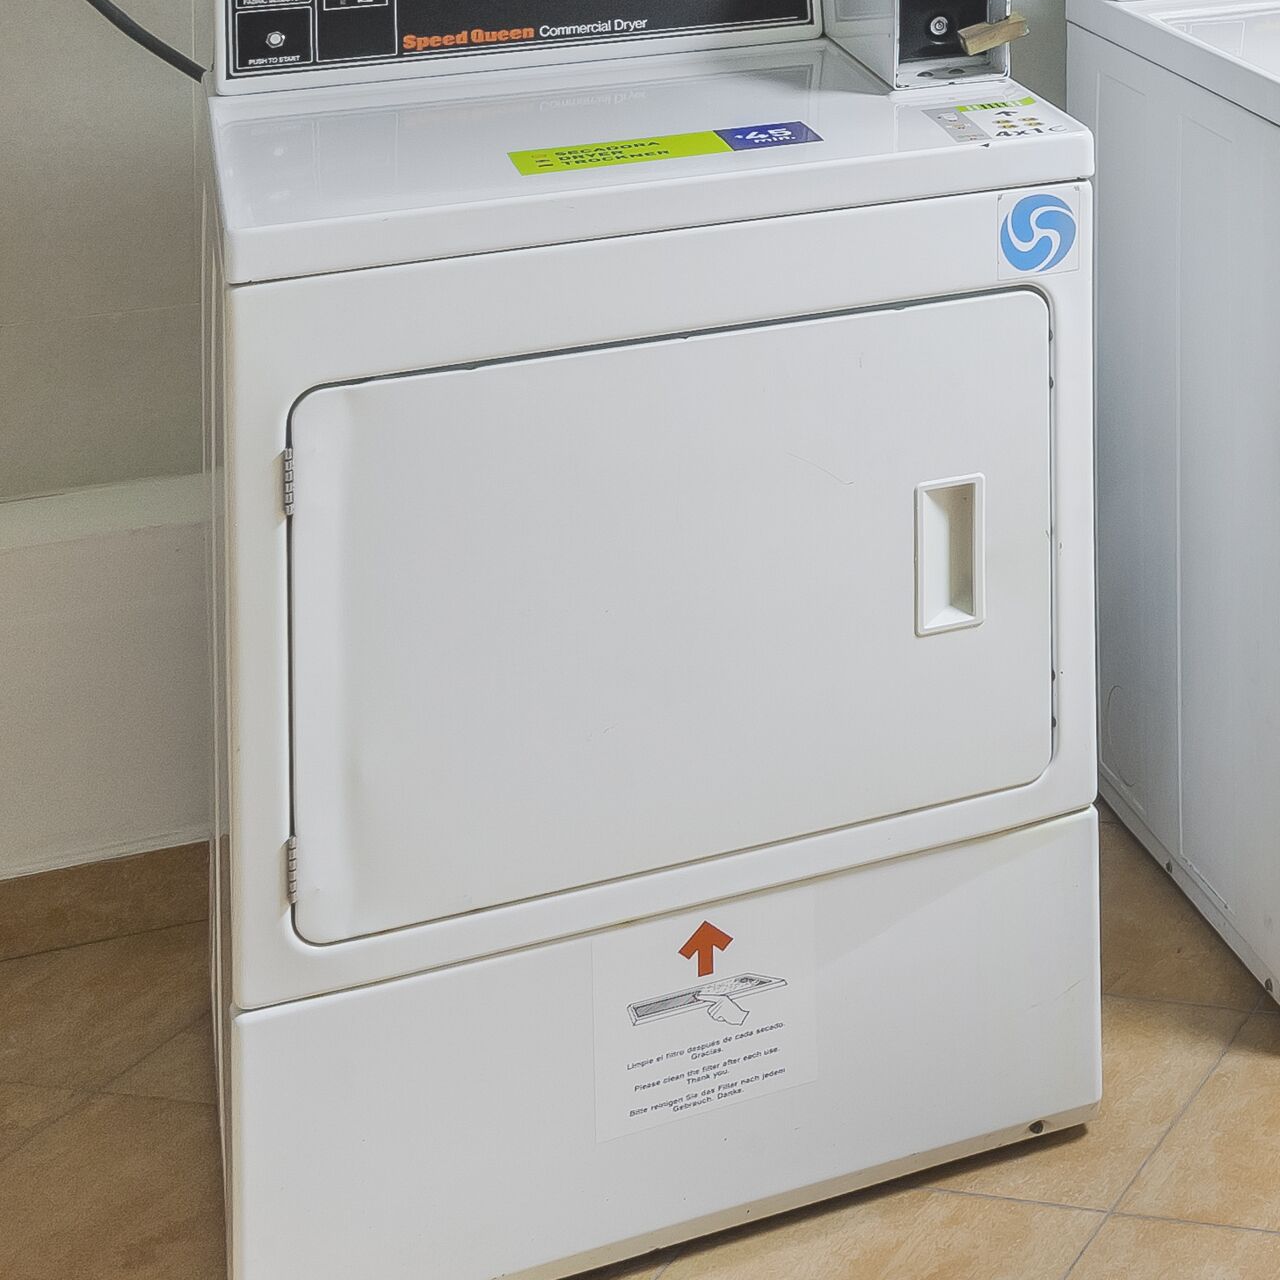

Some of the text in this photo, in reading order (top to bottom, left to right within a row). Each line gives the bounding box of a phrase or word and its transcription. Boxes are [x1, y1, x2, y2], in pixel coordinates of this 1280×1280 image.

[403, 17, 648, 51] Speed Queen Commercial Dryer
